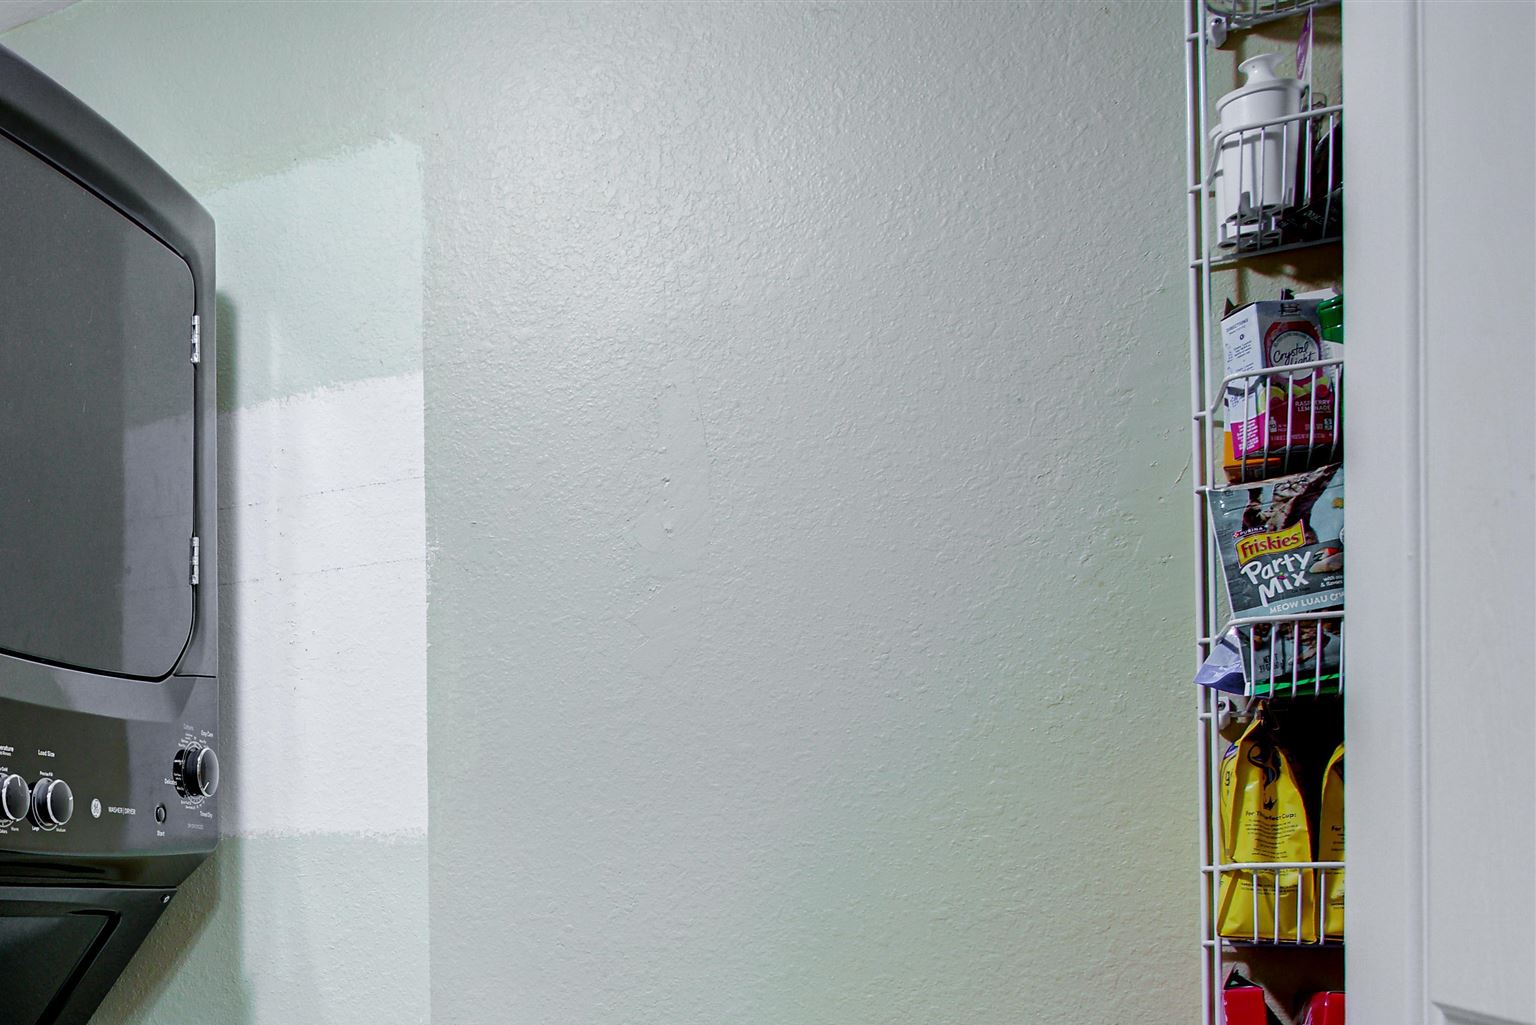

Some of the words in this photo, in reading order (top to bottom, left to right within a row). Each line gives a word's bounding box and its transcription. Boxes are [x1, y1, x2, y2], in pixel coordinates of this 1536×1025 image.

[1273, 341, 1309, 363] Crystal
[1240, 526, 1264, 536] PURINA
[1240, 533, 1300, 559] Friskies
[1240, 551, 1312, 585] Party
[1258, 571, 1309, 608] Mix
[1269, 601, 1300, 615] MEOW
[1301, 595, 1328, 608] LUAU
[37, 749, 47, 757] Load
[47, 750, 55, 758] Size
